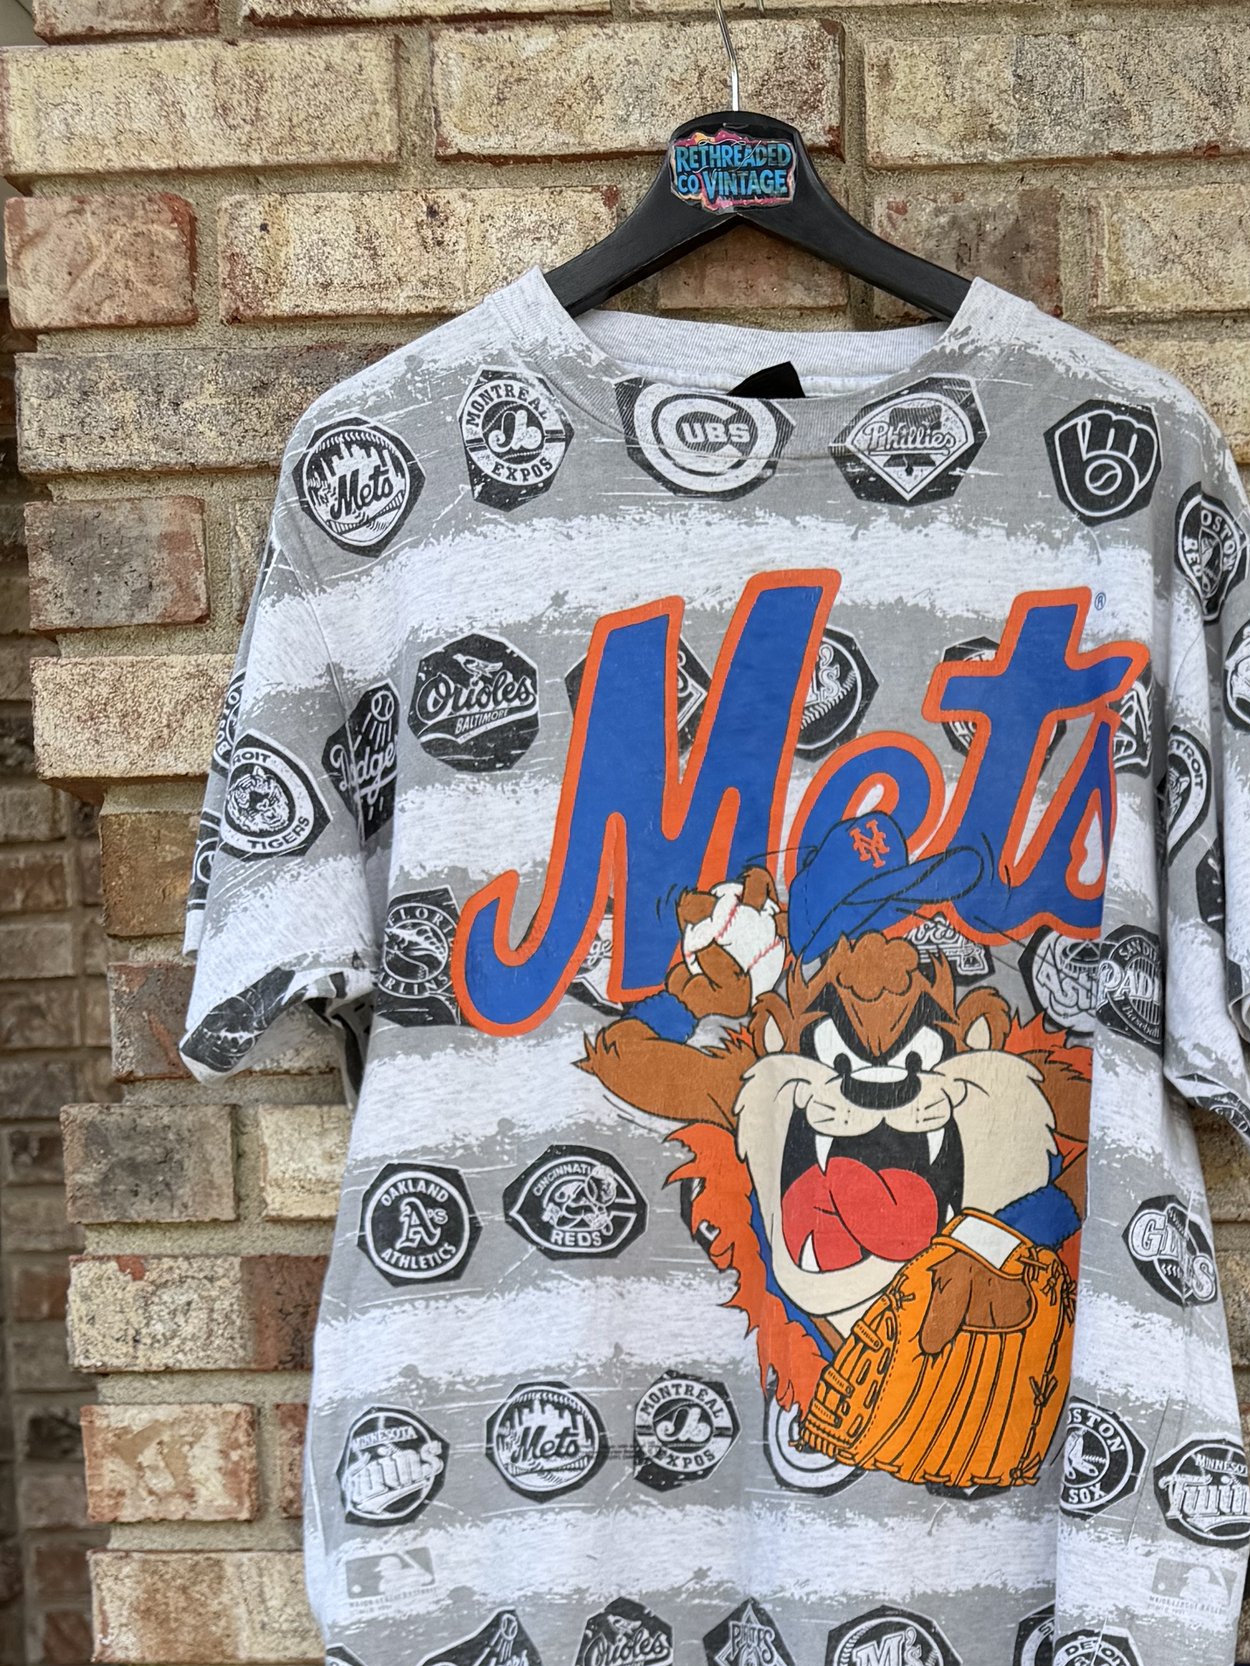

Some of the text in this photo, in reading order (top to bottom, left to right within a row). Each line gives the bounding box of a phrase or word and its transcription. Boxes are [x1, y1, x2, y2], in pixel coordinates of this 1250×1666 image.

[674, 142, 792, 172] RETHREADED
[677, 169, 788, 204] CO VINTAGE
[466, 384, 547, 428] MONTREAL
[863, 420, 957, 450] Phillies
[491, 458, 553, 482] EXPOS
[330, 464, 394, 520] Mets
[416, 670, 538, 724] Orioles
[455, 568, 1151, 1037] Mets
[246, 815, 310, 851] TIGERS
[1119, 940, 1141, 961] SAN
[381, 1180, 449, 1207] OAKLAND
[533, 1163, 592, 1196] CINCINNATI
[551, 1229, 602, 1247] REDS
[381, 1242, 456, 1269] ATHLETICS
[639, 1383, 725, 1419] MONTREAL
[510, 1425, 580, 1464] Mets
[654, 1447, 716, 1470] EXPOS
[1069, 1481, 1107, 1504] SOX
